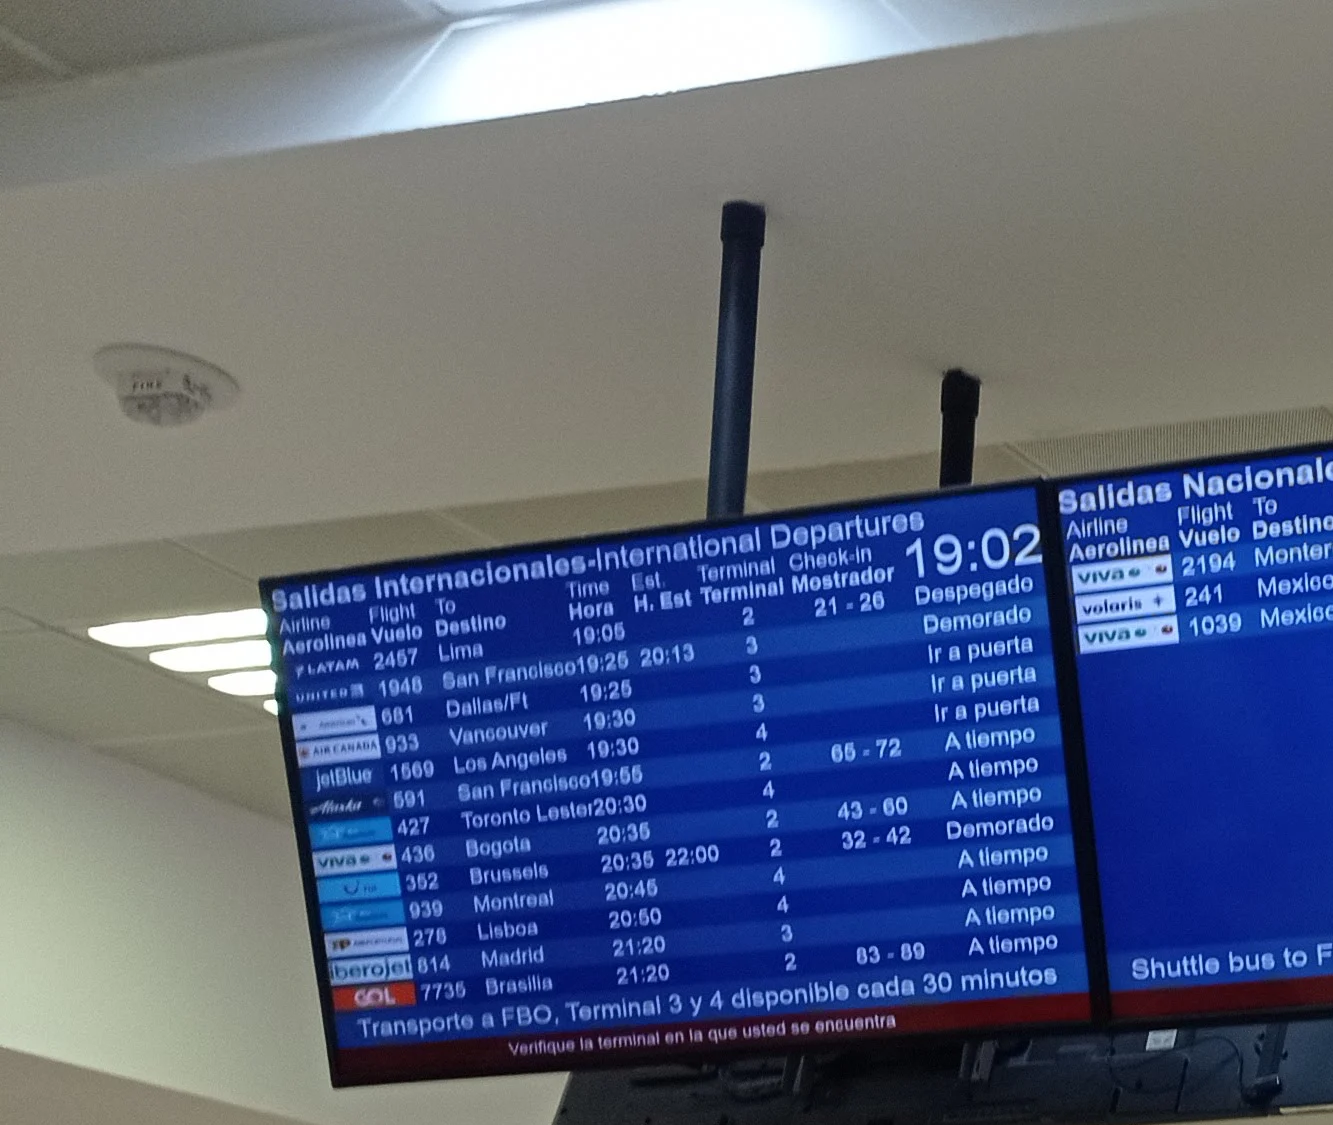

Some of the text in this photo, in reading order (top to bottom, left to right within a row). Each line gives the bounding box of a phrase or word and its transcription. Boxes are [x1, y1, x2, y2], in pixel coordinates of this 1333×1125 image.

[1057, 480, 1172, 514] Salidas
[1066, 517, 1128, 540] Airline
[1177, 501, 1233, 526] Flight
[1252, 496, 1277, 516] To
[1069, 535, 1170, 562] Aerolinea
[1178, 524, 1240, 548] Vuelo
[271, 511, 1043, 612] Salidas Internacionales-International Departures 19:02
[1181, 550, 1236, 576] 2194
[1184, 583, 1222, 607] 241
[438, 643, 484, 662] Lima
[914, 573, 1033, 605] Despegado
[1189, 612, 1242, 637] 1039
[442, 603, 1031, 690] San Francisco Demorado
[445, 691, 528, 718] Dallas/Ft
[448, 721, 548, 746] Vancouver
[583, 707, 636, 731] 19:30
[453, 756, 487, 774] Los
[491, 746, 567, 770] Angeles
[587, 736, 639, 759] 19:30
[457, 774, 589, 801] San Francisco
[460, 793, 647, 829] Toronto Lester 20:30
[465, 835, 531, 858] Bogota
[469, 812, 1054, 885] Brussels 22:00 Demorado
[473, 888, 554, 913] Montreal
[477, 920, 538, 940] Lisboa
[481, 945, 544, 968] Madrid
[612, 935, 666, 957] 21:20
[1131, 953, 1220, 980] Shuttle
[1228, 950, 1275, 973] bus
[1283, 947, 1308, 968] to
[485, 974, 553, 995] Brasilia
[616, 963, 670, 985] 21:20
[357, 966, 1058, 1038] Transporte a FBO, Terminal 3 y 4 disponible cada 30 minutos
